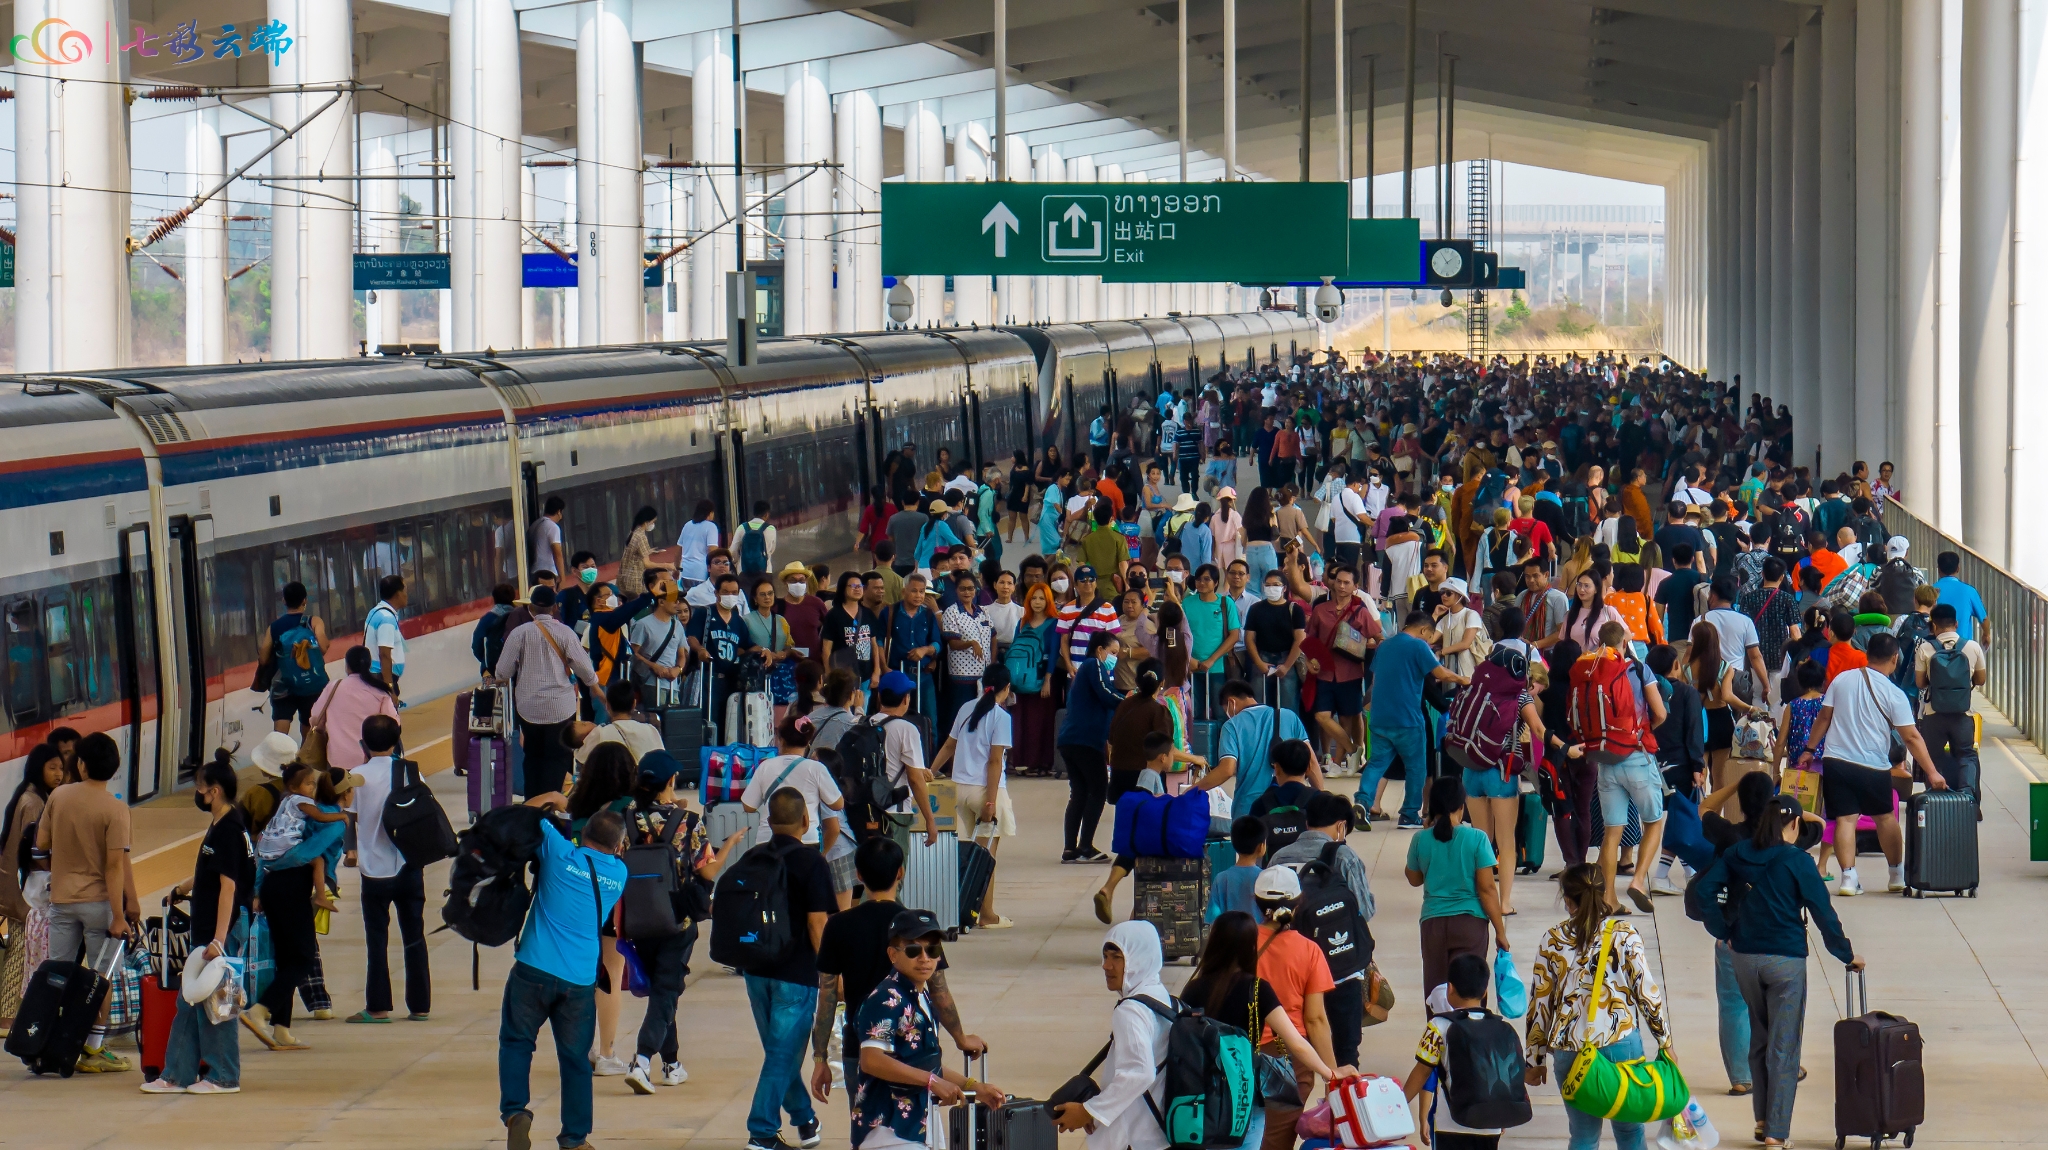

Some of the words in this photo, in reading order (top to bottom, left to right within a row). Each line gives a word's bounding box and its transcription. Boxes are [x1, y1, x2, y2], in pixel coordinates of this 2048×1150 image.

[1114, 194, 1221, 219] ທາງອອກ
[1114, 220, 1176, 241] 出站口
[1114, 248, 1144, 263] Exit
[718, 640, 734, 662] 50
[1316, 901, 1345, 916] adidas
[1329, 943, 1354, 955] adidas
